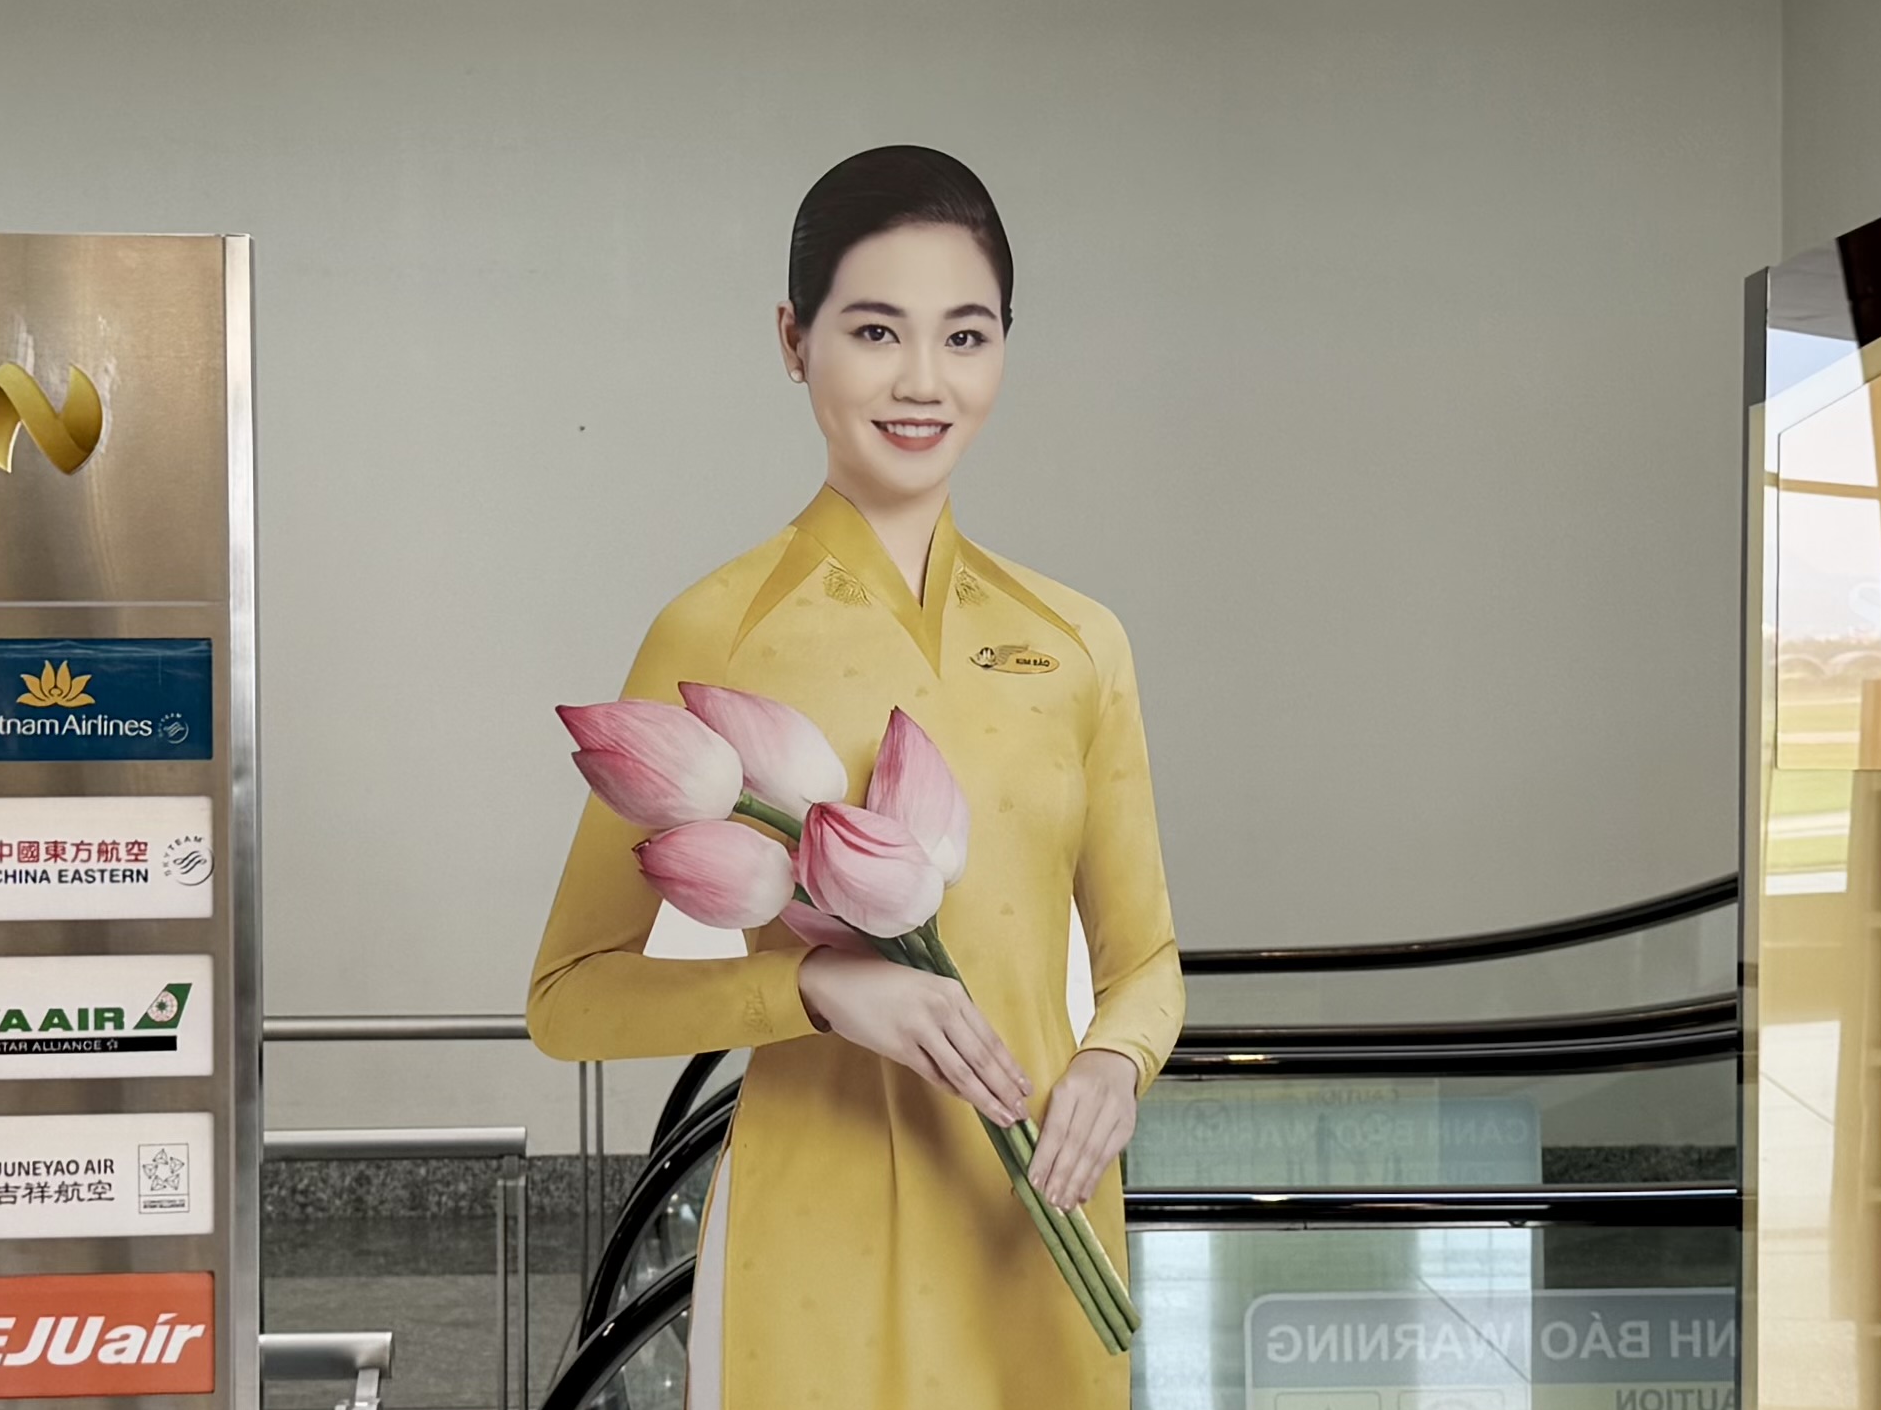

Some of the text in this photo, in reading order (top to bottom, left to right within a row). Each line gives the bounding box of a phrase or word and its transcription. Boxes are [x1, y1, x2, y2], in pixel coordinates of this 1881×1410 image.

[62, 714, 152, 736] Airlines
[58, 869, 149, 884] EASTERN
[32, 1040, 101, 1052] ALLIANCE
[84, 1159, 114, 1175] AIR
